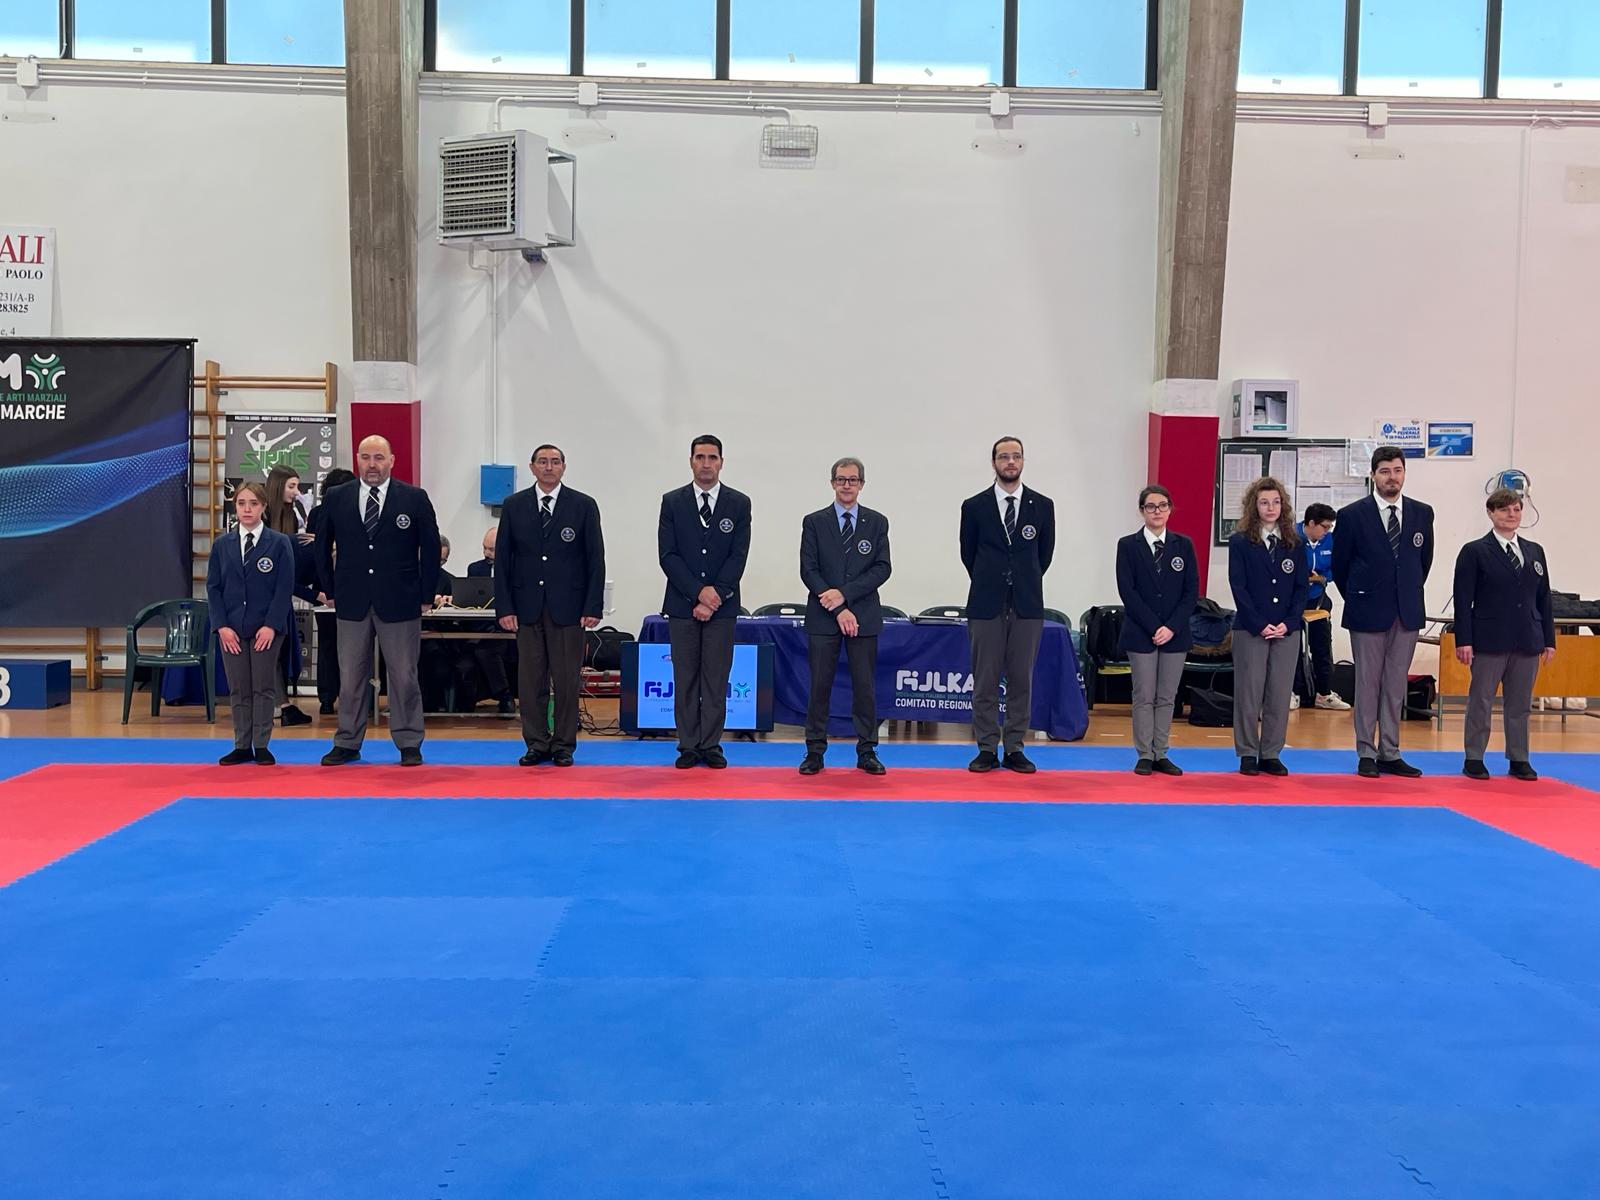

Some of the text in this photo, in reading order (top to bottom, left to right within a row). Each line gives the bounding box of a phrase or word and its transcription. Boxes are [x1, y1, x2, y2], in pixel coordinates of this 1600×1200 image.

[0, 234, 45, 264] ALI
[6, 269, 43, 280] PAOLO
[6, 393, 25, 401] ARTI
[27, 393, 67, 402] MARZIALI
[0, 404, 66, 420] MARCHE
[896, 670, 975, 694] FIJLKA
[895, 698, 973, 710] COMITATO REGIONA
